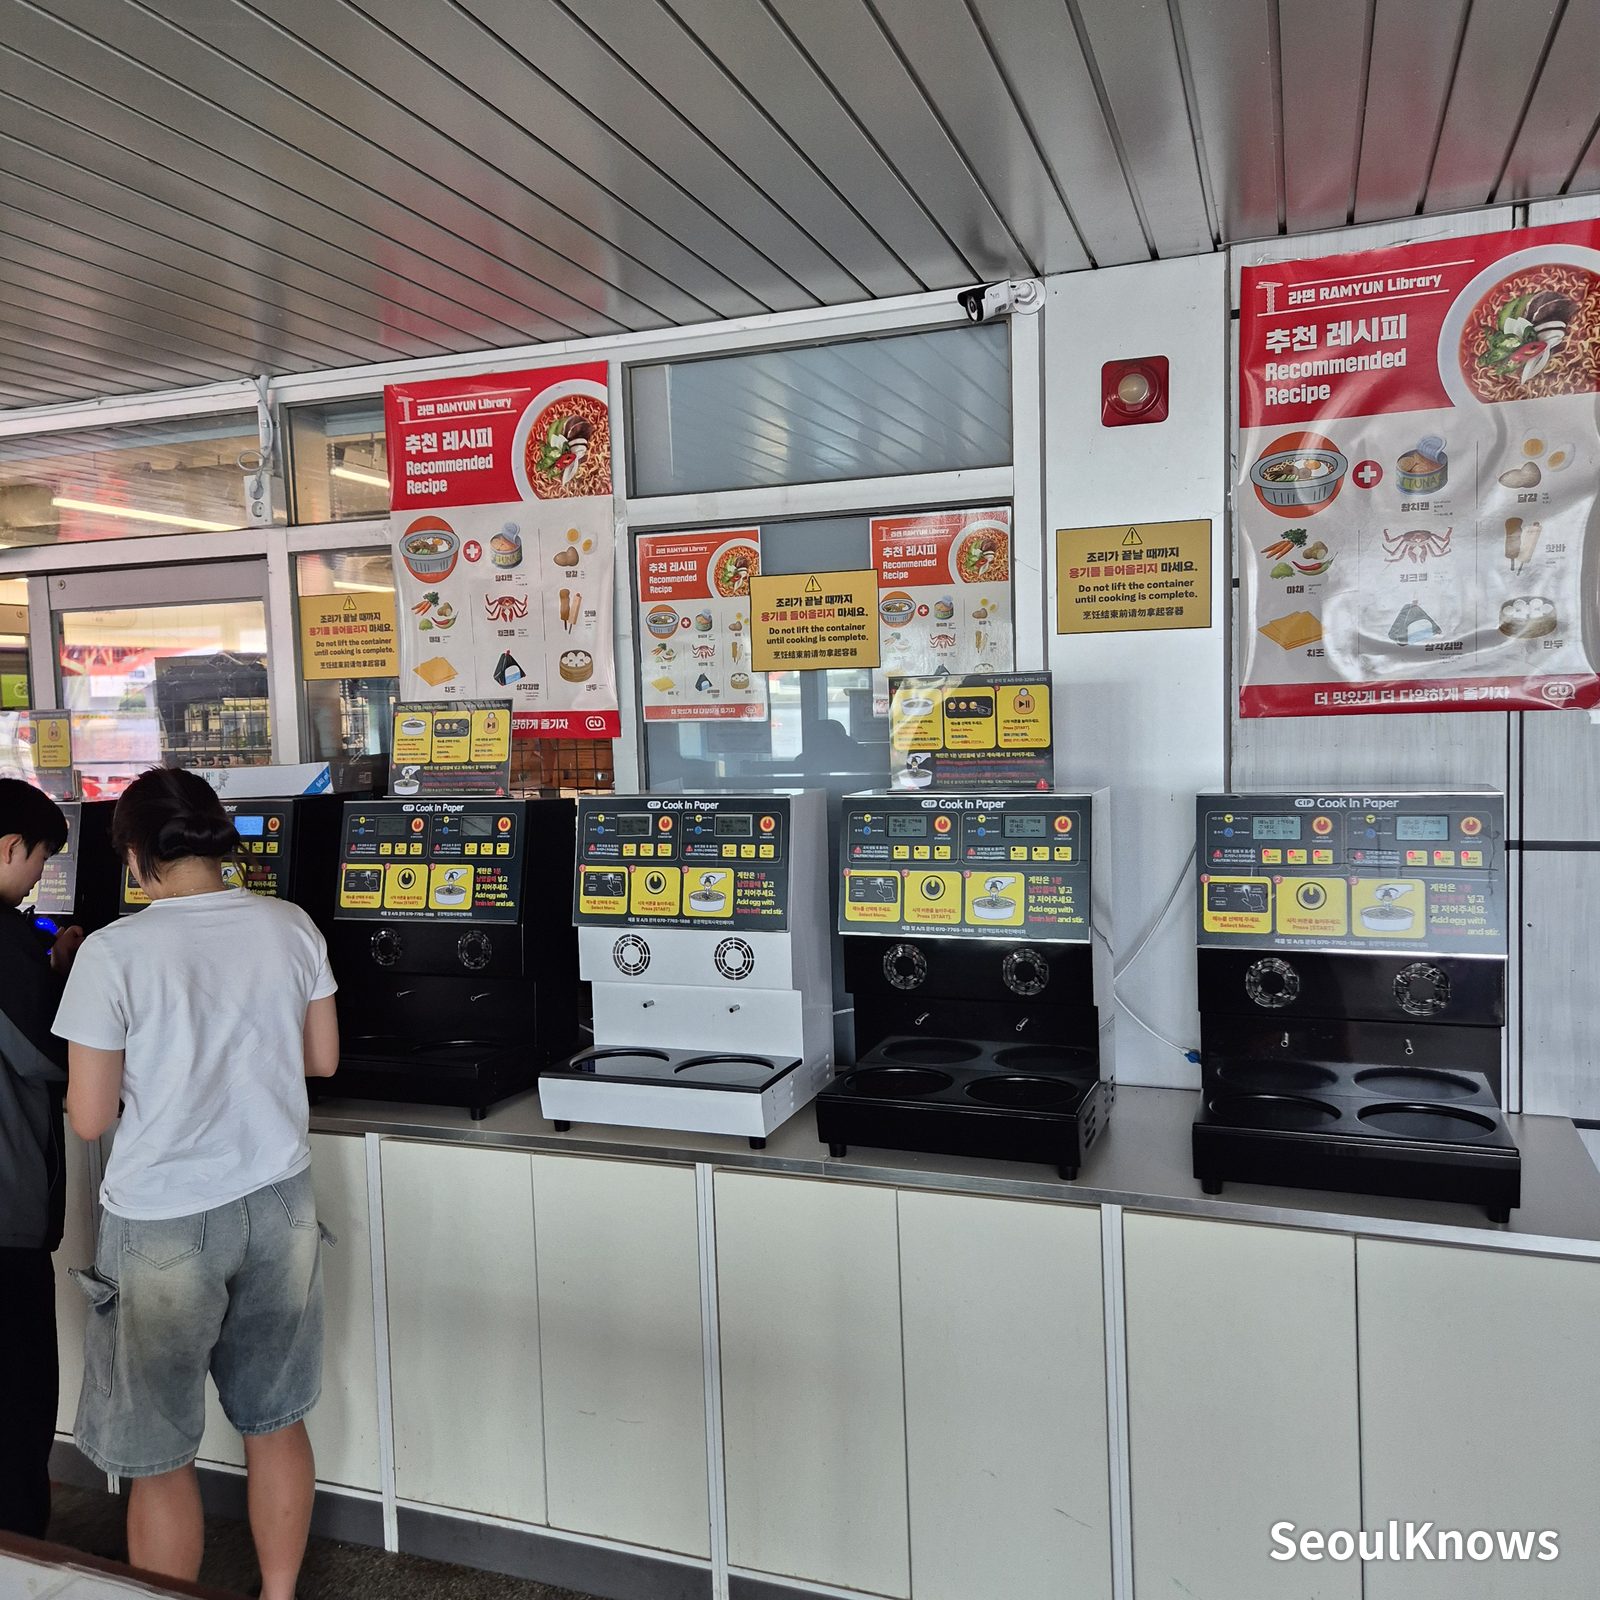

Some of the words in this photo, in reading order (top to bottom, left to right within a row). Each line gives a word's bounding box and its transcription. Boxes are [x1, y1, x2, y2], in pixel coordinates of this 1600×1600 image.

[1287, 288, 1316, 306] 라면
[1319, 279, 1384, 301] RAMYUN
[1387, 273, 1443, 292] Library
[1265, 325, 1318, 355] 추천
[1326, 312, 1407, 348] 레시피
[1265, 347, 1407, 382] Recommended
[1265, 382, 1331, 406] Recipe
[417, 404, 435, 417] 라면
[436, 400, 477, 414] RAMYUN
[478, 397, 512, 410] Library
[405, 432, 438, 455] 추천
[442, 427, 493, 451] 레시피
[406, 454, 494, 476] Recommended
[406, 478, 448, 496] Recipe
[1404, 474, 1439, 489] TUNA
[1400, 499, 1430, 513] 참치캔
[883, 546, 902, 558] 추천
[906, 544, 937, 556] 레시피
[1086, 550, 1119, 563] 조리가
[1121, 548, 1144, 561] 끝날
[1146, 546, 1180, 559] 때까지
[649, 563, 667, 574] 추천
[669, 560, 697, 572] 레시피
[883, 558, 937, 569] Recommended
[1069, 566, 1101, 580] 용기를
[1103, 563, 1158, 577] 들어올리지
[1160, 560, 1198, 573] 마세요.
[649, 574, 698, 584] Recommended
[883, 570, 908, 580] Recipe
[649, 585, 673, 595] Recipe
[1078, 584, 1091, 593] Do
[1093, 583, 1109, 592] not
[1111, 581, 1126, 591] lift
[1128, 580, 1145, 590] the
[1146, 578, 1195, 589] container
[775, 597, 803, 608] 조리가
[804, 596, 823, 607] 끝날
[825, 594, 853, 605] 때까지
[1075, 594, 1097, 604] until
[1098, 592, 1137, 604] cooking
[1137, 591, 1147, 600] is
[1148, 589, 1198, 601] complete.
[320, 614, 342, 624] 조리가
[358, 611, 381, 622] 때까지
[761, 610, 788, 622] 용기를
[789, 609, 835, 621] 들어올리지
[837, 607, 869, 618] 마세요.
[308, 626, 330, 636] 용기를
[369, 622, 394, 633] 마세요.
[769, 627, 780, 636] Do
[781, 626, 795, 635] not
[796, 625, 809, 634] lift
[810, 624, 824, 633] the
[825, 623, 866, 632] container
[360, 637, 392, 645] container
[766, 636, 784, 645] until
[786, 635, 819, 645] cooking
[819, 634, 827, 642] is
[827, 633, 869, 643] complete.
[1543, 640, 1564, 650] 만두
[329, 648, 355, 656] cooking
[1306, 647, 1326, 658] 치즈
[1423, 640, 1464, 652] 삼각김밥
[1314, 692, 1329, 706] 더
[1332, 689, 1376, 706] 맛있게
[1380, 689, 1396, 704] 더
[1398, 688, 1459, 703] 다양하게
[1463, 685, 1511, 701] 즐기자
[512, 718, 540, 730] 양하게
[540, 717, 569, 730] 즐기자
[415, 803, 434, 812] Cook
[434, 803, 442, 812] In
[442, 803, 464, 813] Paper
[662, 800, 684, 810] Cook
[684, 800, 693, 809] In
[693, 800, 719, 811] Paper
[938, 799, 964, 809] Cook
[964, 799, 975, 809] In
[975, 799, 1006, 810] Paper
[1295, 799, 1315, 807] CIP
[1316, 798, 1348, 808] Cook
[1349, 798, 1360, 808] In
[1362, 798, 1400, 810] Paper
[736, 898, 750, 906] Add
[749, 899, 761, 907] egg
[761, 898, 775, 906] with
[761, 907, 773, 915] and
[1028, 905, 1044, 913] Add
[1044, 906, 1058, 915] egg
[1057, 905, 1074, 913] with
[1057, 915, 1071, 923] and
[1071, 915, 1085, 924] stir.
[1430, 915, 1449, 924] Add
[1449, 917, 1467, 926] egg
[1466, 916, 1487, 925] with
